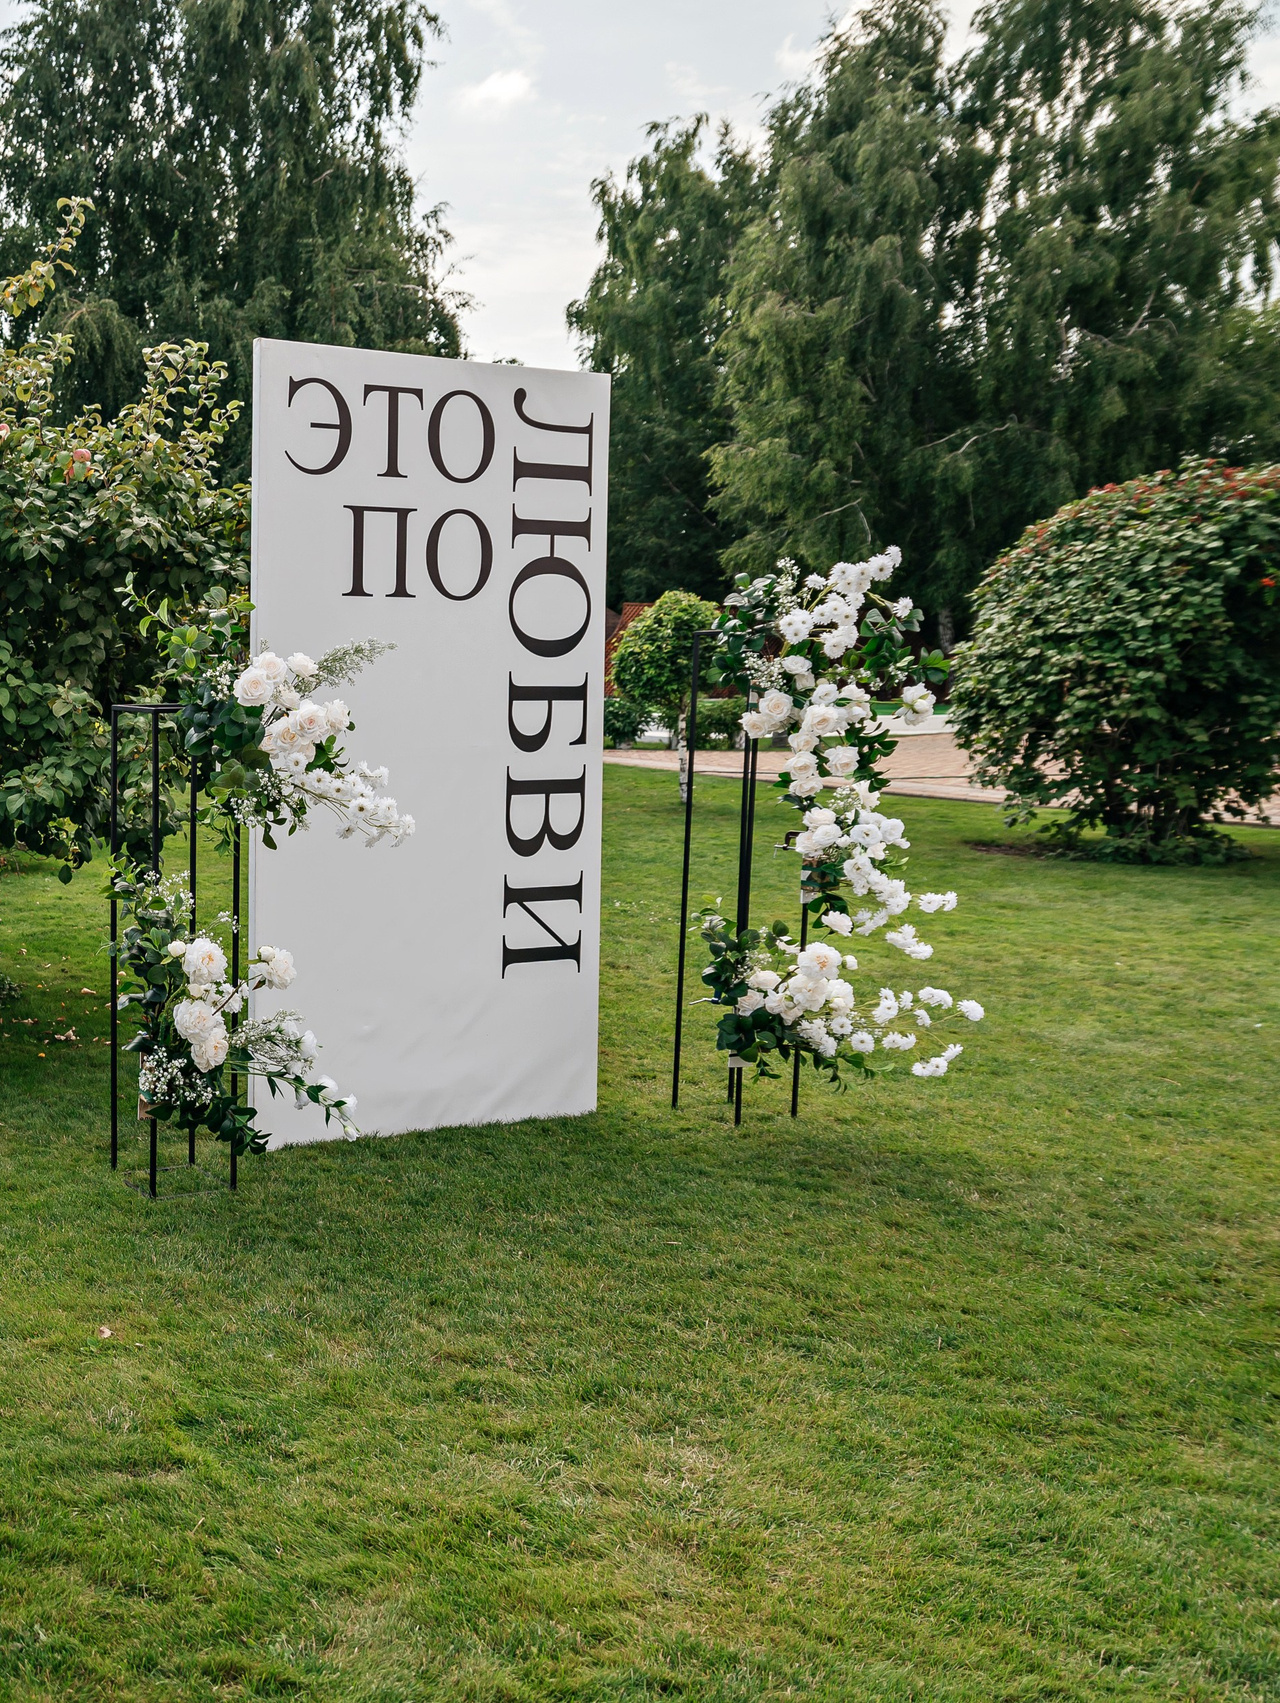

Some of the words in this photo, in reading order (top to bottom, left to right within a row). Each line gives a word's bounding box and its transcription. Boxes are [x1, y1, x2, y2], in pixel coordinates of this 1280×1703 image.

[284, 375, 496, 484] ЭТО
[341, 504, 493, 602] ПО
[501, 387, 595, 980] ЛЮБВИ
